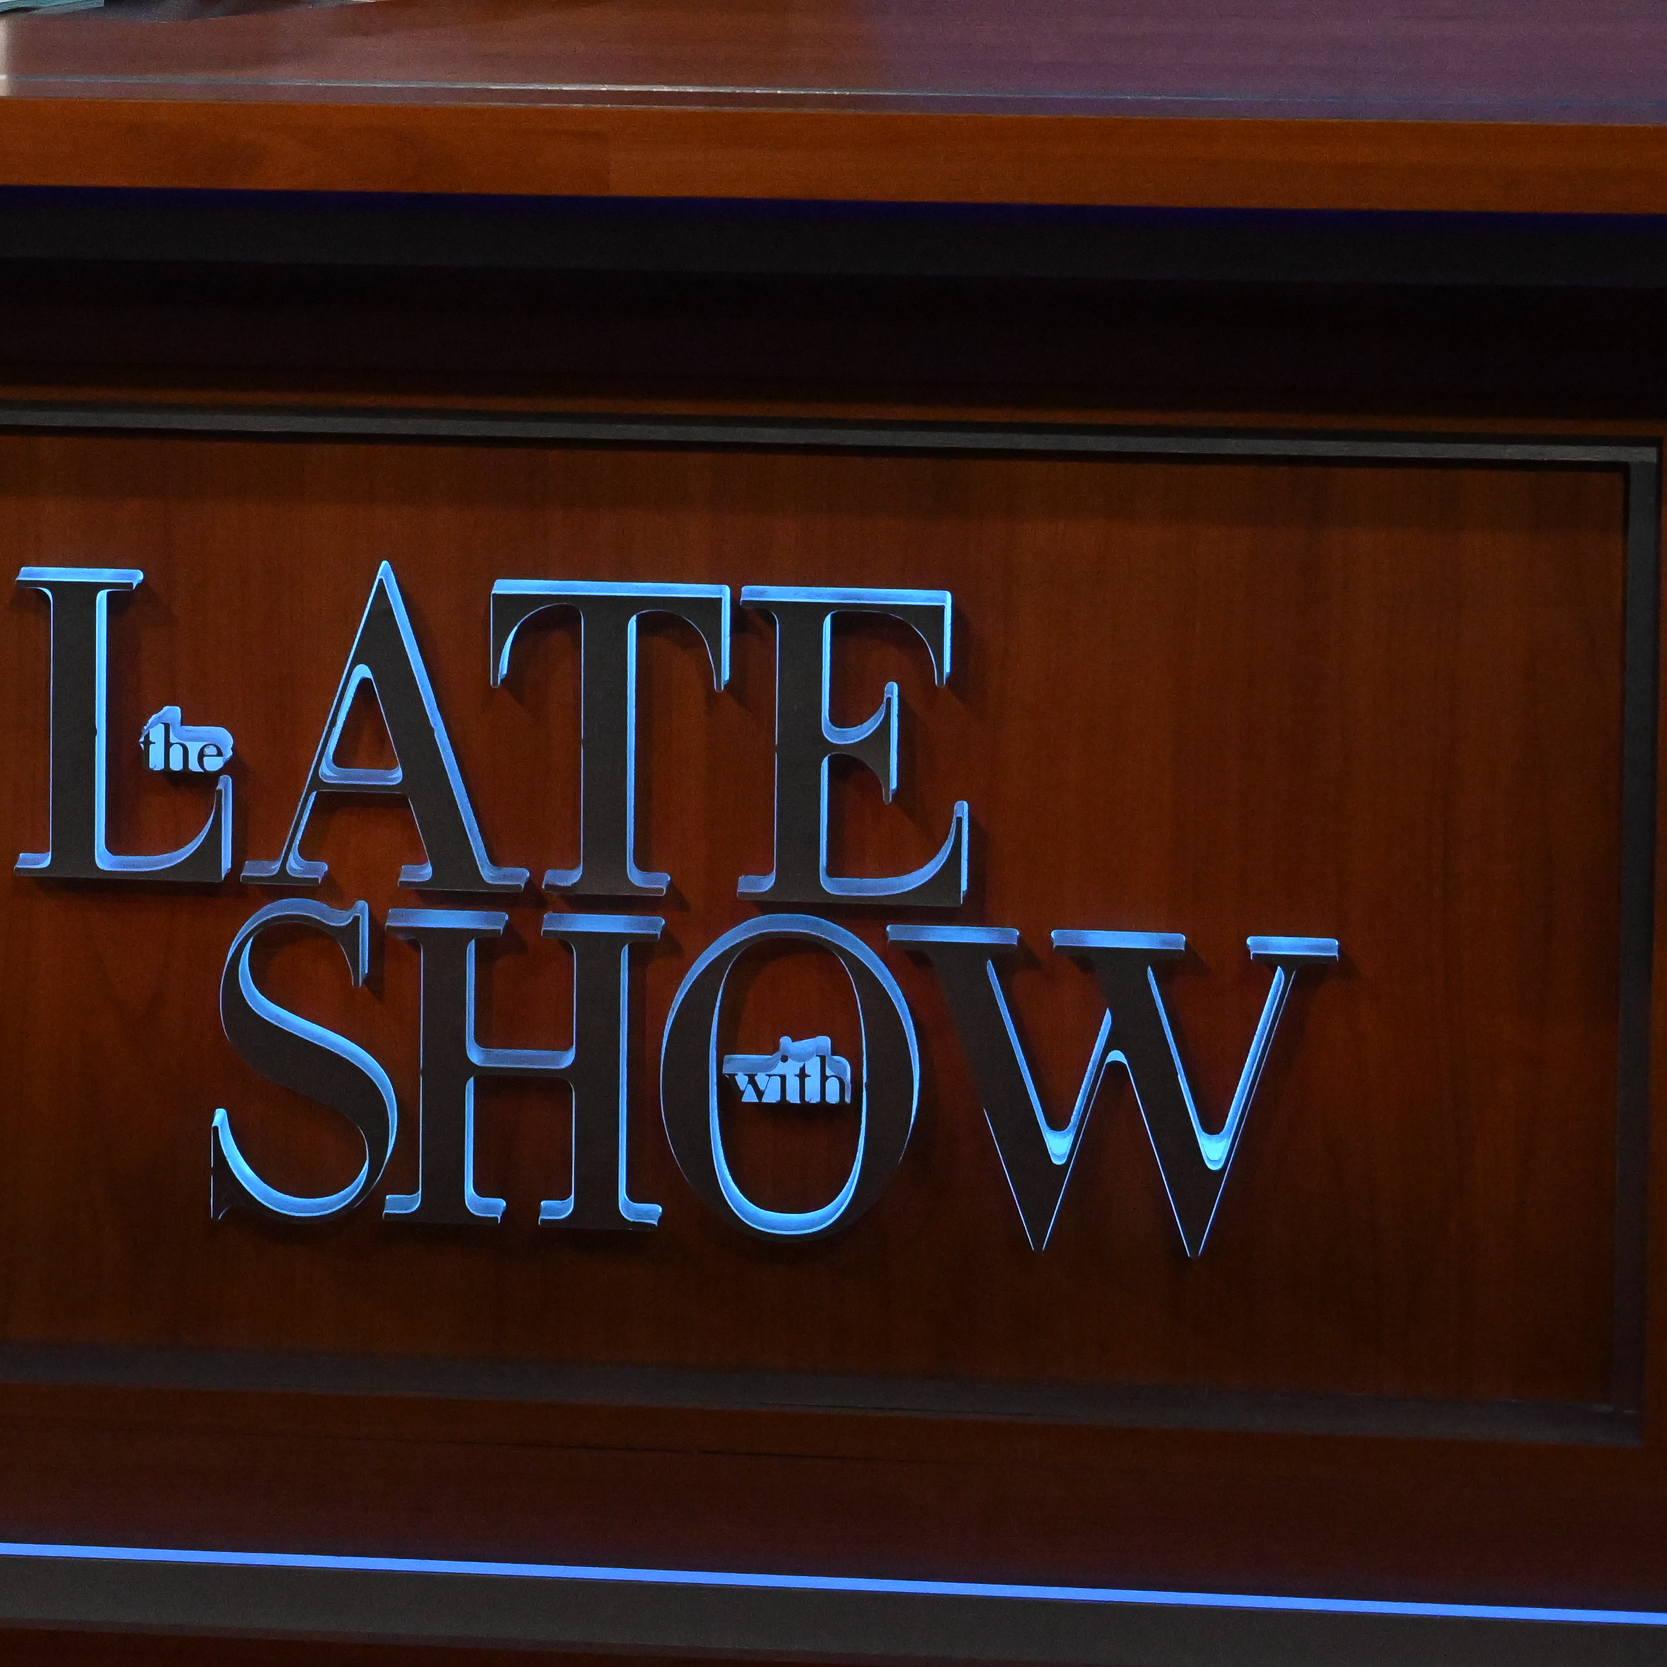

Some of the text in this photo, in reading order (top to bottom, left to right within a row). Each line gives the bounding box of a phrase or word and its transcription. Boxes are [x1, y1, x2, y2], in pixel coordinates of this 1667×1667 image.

[13, 560, 970, 907] LATE
[139, 708, 234, 773] the
[210, 897, 1340, 1258] SHOW
[722, 1040, 852, 1105] with
